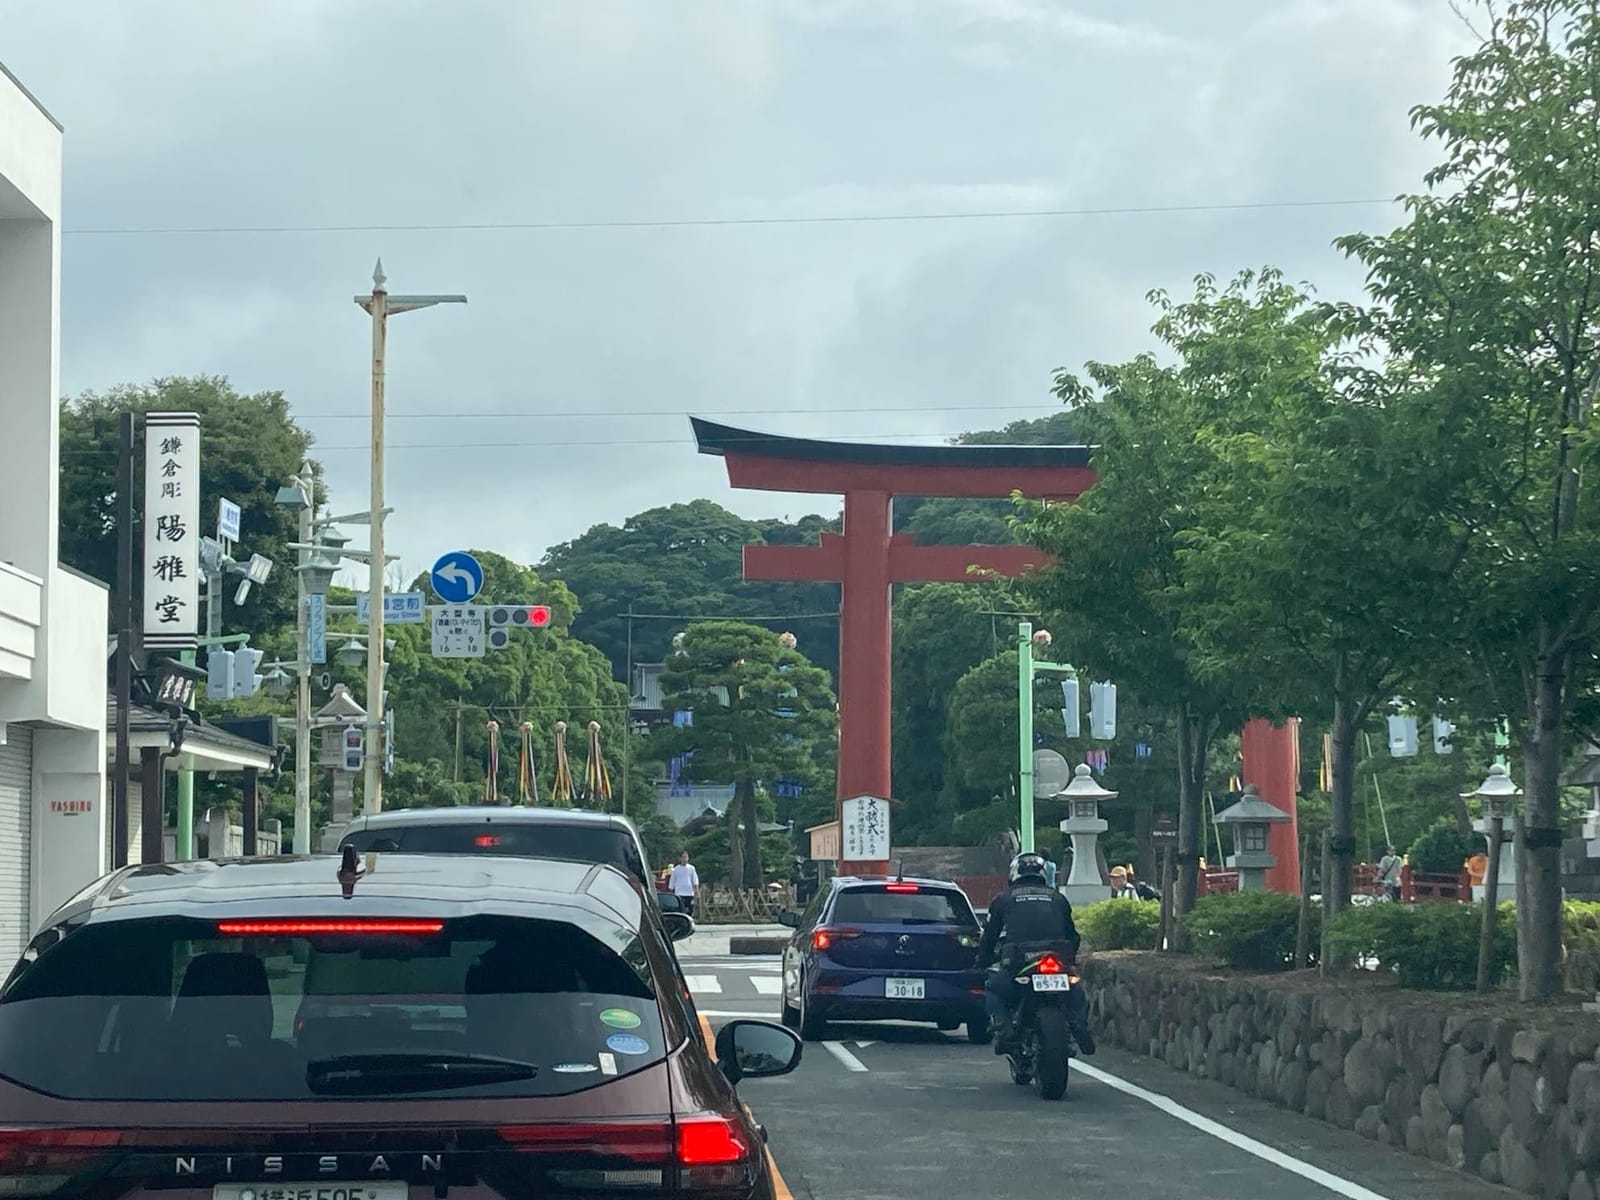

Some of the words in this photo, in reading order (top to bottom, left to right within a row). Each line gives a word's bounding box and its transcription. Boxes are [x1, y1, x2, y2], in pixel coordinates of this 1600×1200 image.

[160, 436, 183, 499] 鎌倉彫
[152, 514, 187, 623] 陽雅堂
[175, 1154, 443, 1174] NISSAN
